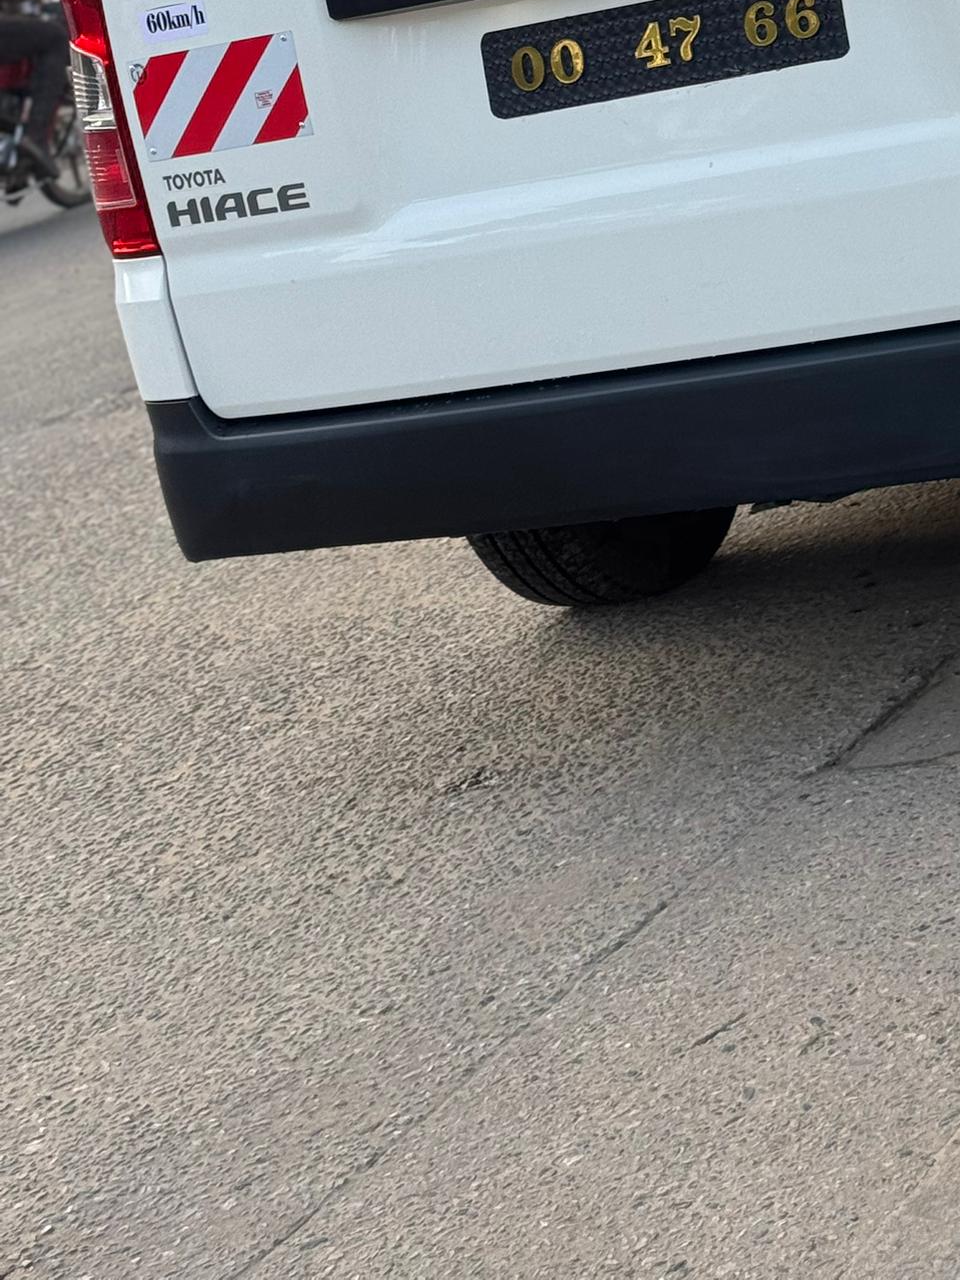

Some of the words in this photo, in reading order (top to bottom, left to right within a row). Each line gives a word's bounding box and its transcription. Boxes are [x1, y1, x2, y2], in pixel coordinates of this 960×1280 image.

[146, 4, 206, 34] 60km/h
[511, 38, 584, 92] 00
[635, 15, 701, 69] 47
[163, 168, 226, 191] TOYOTA
[166, 182, 310, 228] HIACE
